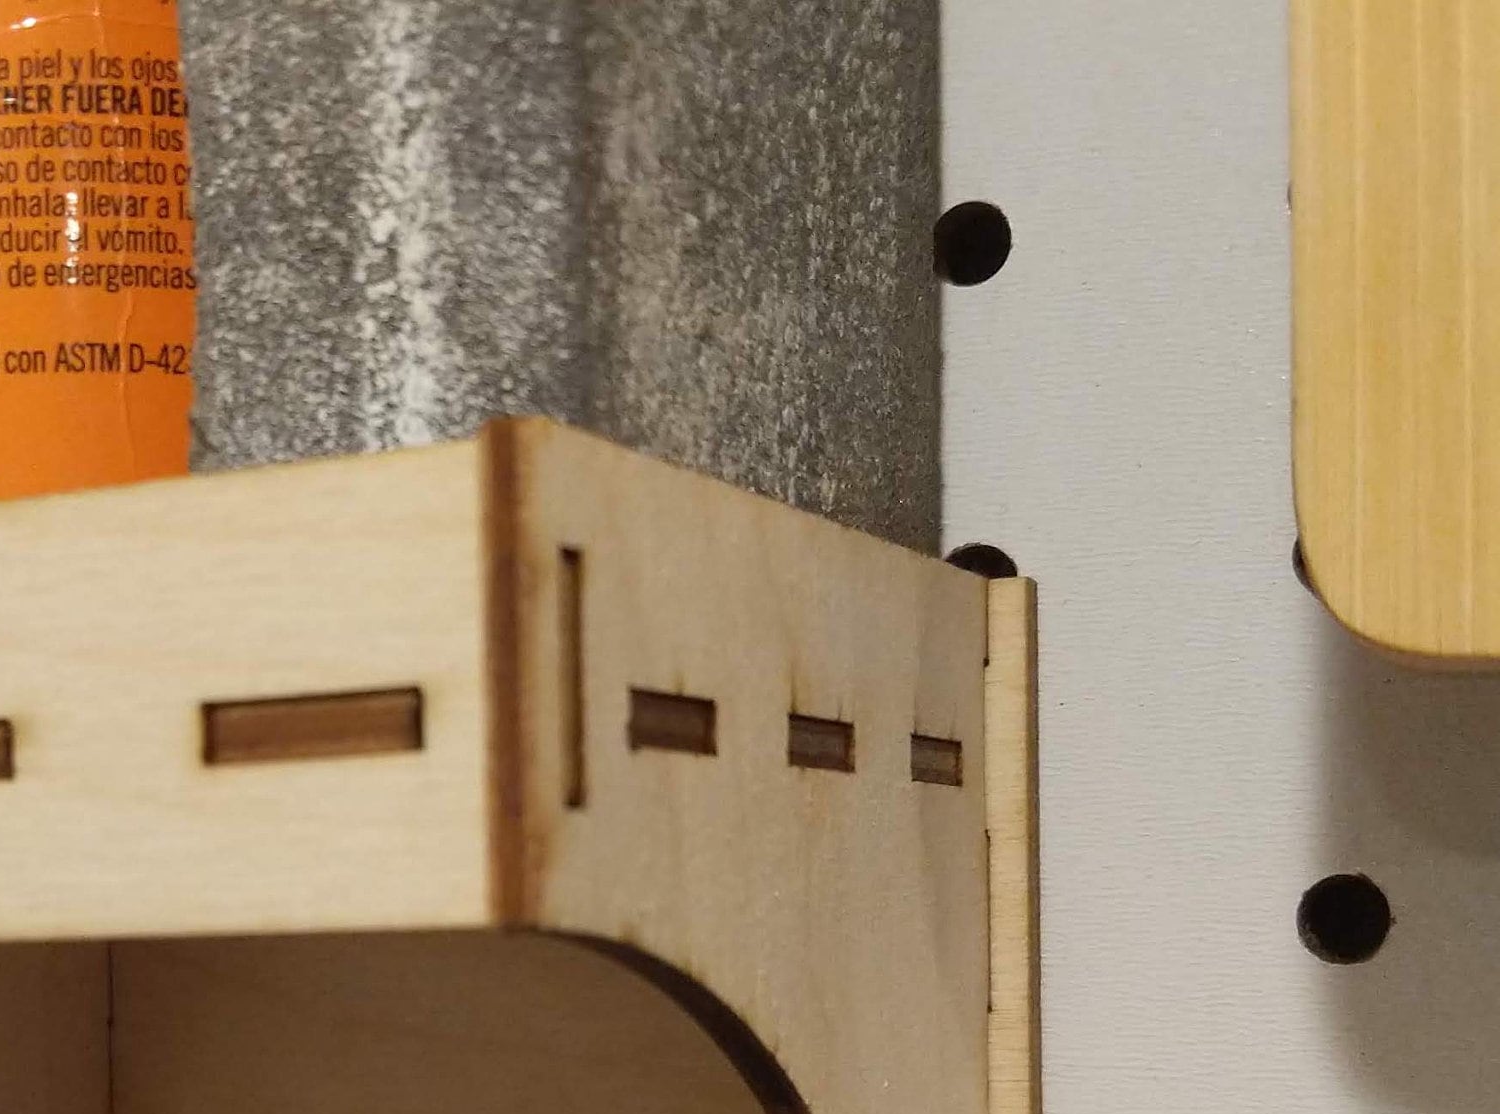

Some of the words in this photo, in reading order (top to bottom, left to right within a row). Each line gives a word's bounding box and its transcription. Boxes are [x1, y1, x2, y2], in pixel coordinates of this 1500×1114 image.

[19, 48, 62, 86] piel
[70, 57, 85, 82] y
[90, 48, 125, 80] los
[132, 52, 180, 87] ojos
[61, 83, 143, 116] FUERA
[100, 125, 143, 149] con
[151, 120, 184, 151] los
[25, 154, 56, 183] de
[63, 153, 167, 184] contacto
[83, 188, 148, 217] llevar
[156, 196, 170, 219] a
[8, 258, 37, 287] de
[4, 349, 47, 375] con
[54, 343, 122, 374] ASTM
[129, 343, 191, 375] D-42
